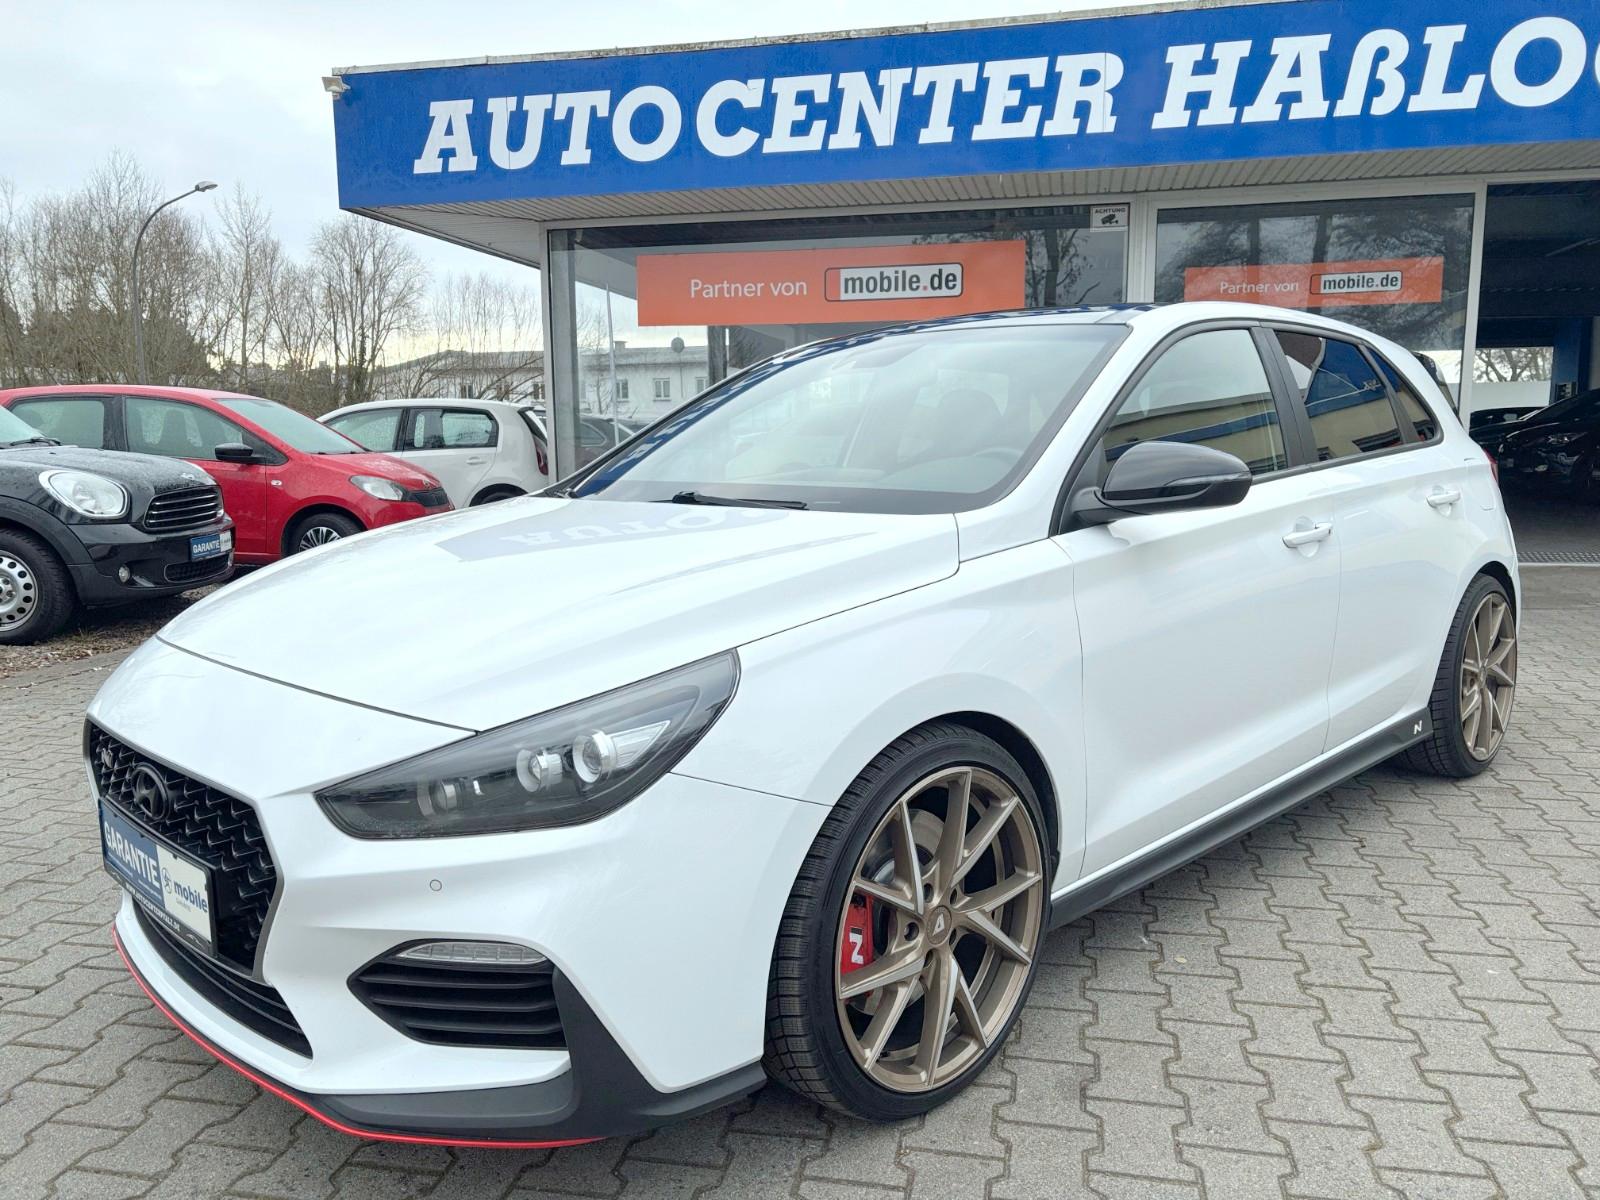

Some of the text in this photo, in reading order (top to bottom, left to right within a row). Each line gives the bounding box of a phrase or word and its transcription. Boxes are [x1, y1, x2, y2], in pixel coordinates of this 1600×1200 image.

[1152, 16, 1600, 130] HAßLO
[690, 268, 958, 299] Partner von mobile.de
[1220, 273, 1399, 295] Partner von mobile.de
[192, 539, 220, 554] GARANTIE
[1413, 719, 1423, 735] N
[104, 821, 161, 889] GARANTIE
[174, 880, 209, 913] mobile
